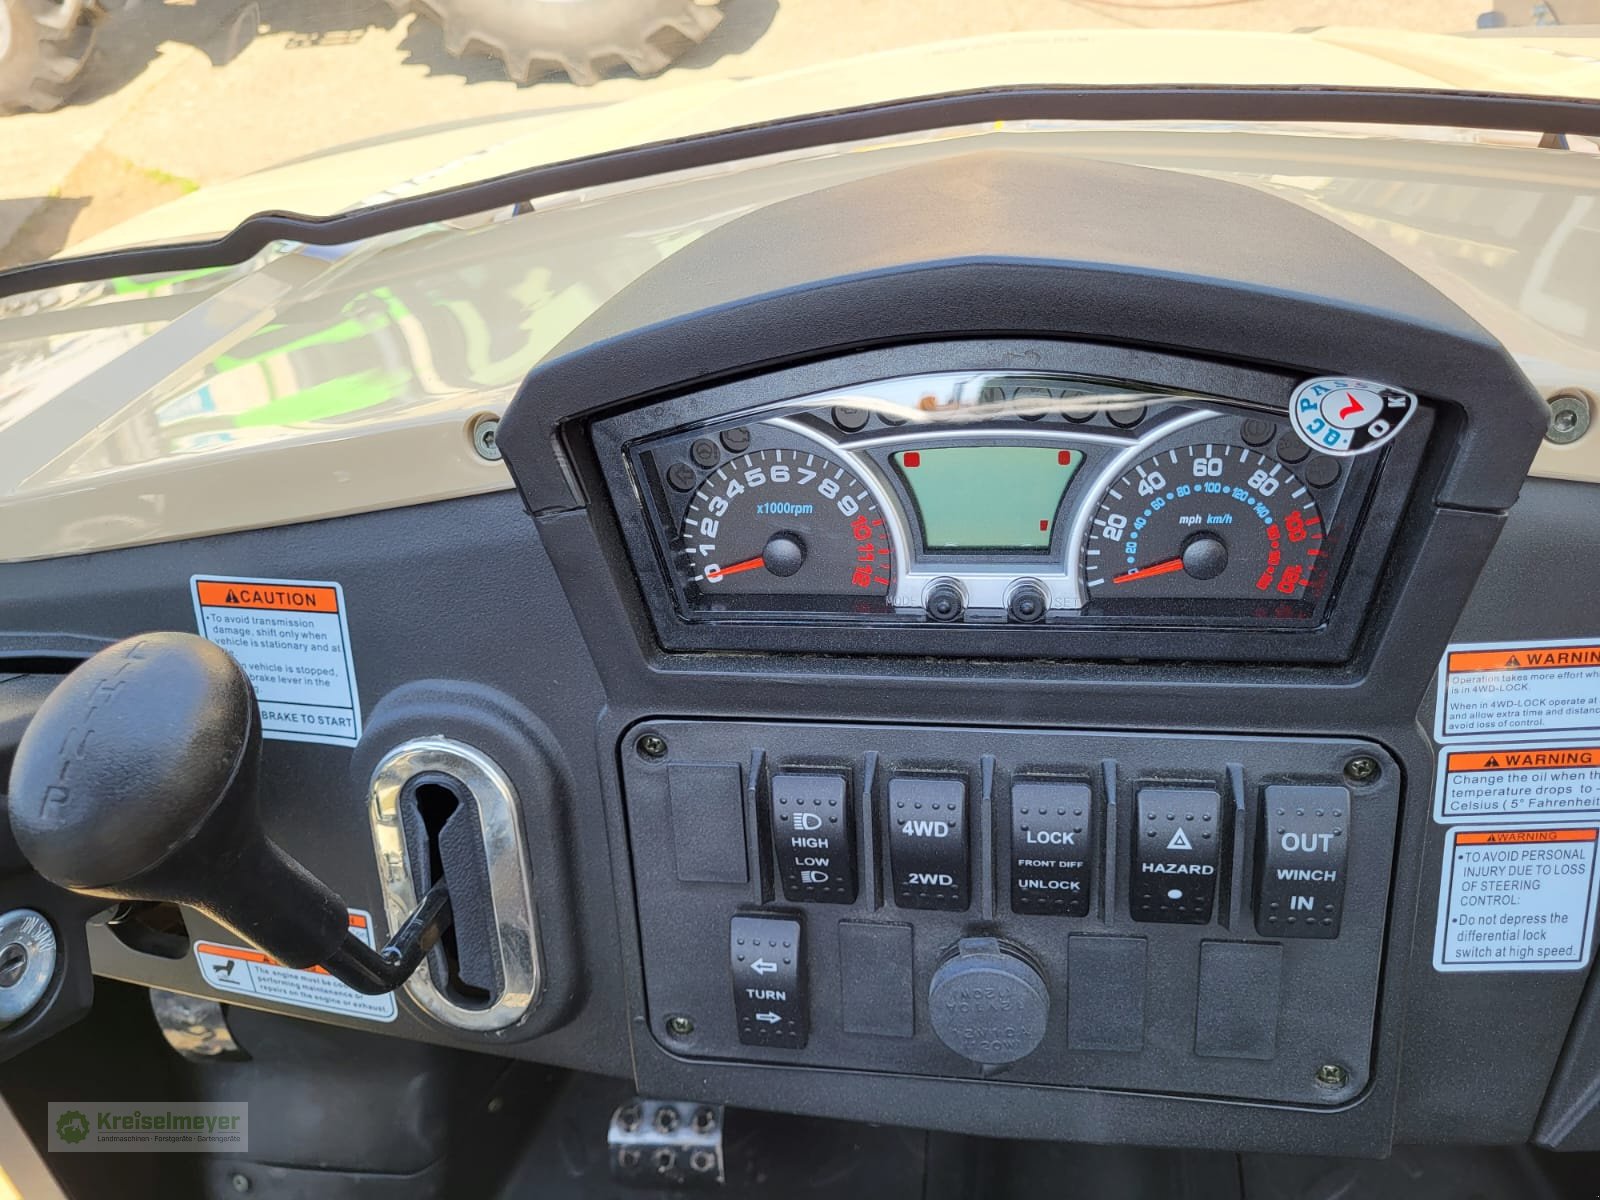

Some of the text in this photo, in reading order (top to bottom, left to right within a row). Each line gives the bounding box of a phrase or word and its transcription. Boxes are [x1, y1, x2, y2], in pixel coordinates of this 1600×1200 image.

[770, 465, 790, 482] 6
[1193, 457, 1223, 477] 60
[744, 467, 767, 487] 5
[797, 468, 816, 485] 7
[1247, 469, 1279, 497] 80
[725, 478, 745, 499] 4
[817, 478, 840, 500] 8
[1137, 471, 1166, 497] 40
[1176, 485, 1191, 497] 80
[1204, 482, 1221, 493] 100
[1231, 487, 1249, 501] 120
[708, 495, 729, 517] 3
[756, 502, 813, 517] x1000rpm
[837, 495, 859, 517] 9
[1150, 497, 1166, 510] 60
[1252, 502, 1270, 519] 140
[1133, 516, 1147, 530] 40
[1179, 513, 1233, 527] mph km/h
[700, 518, 719, 538] 2
[851, 515, 872, 541] 10
[1102, 513, 1127, 542] 20
[699, 544, 716, 557] 1
[857, 543, 875, 563] 11
[1125, 541, 1137, 554] 20
[704, 563, 724, 584] 0
[851, 565, 873, 588] 12
[240, 589, 317, 607] CAUTION
[211, 614, 314, 628] To avoid transmission
[213, 625, 328, 641] damage, shift only when
[215, 637, 341, 652] vehicle is stationary and at
[249, 663, 282, 672] vehicle
[285, 665, 294, 673] is
[295, 666, 339, 677] stopped,
[250, 673, 330, 687] brake lever in the
[1452, 674, 1500, 685] Operation
[1502, 673, 1528, 682] takes
[1530, 673, 1555, 681] more
[1557, 671, 1583, 680] effort
[1461, 686, 1470, 694] in
[1450, 696, 1597, 711] When in 4WD-LOCK operate at
[262, 710, 352, 727] BRAKE TO START
[1449, 711, 1467, 720] and
[1469, 710, 1494, 719] allow
[1496, 709, 1520, 718] extra
[1522, 708, 1543, 717] time
[1545, 707, 1563, 715] and
[1448, 718, 1545, 730] avoid loss of control.
[1505, 752, 1592, 766] WARNING
[1453, 774, 1504, 786] Change
[1507, 772, 1528, 783] the
[1531, 771, 1547, 782] oil
[1550, 770, 1585, 781] when
[1451, 783, 1592, 799] temperature drops to
[1450, 799, 1499, 811] Celsius
[902, 820, 949, 838] 4WD
[791, 837, 829, 849] HIGH
[1026, 830, 1075, 845] LOCK
[1281, 832, 1335, 853] OUT
[1497, 832, 1557, 842] WARNING
[794, 857, 830, 867] LOW
[1466, 849, 1586, 863] TO AVOID PERSONAL
[1018, 859, 1084, 869] FRONT DIFF
[1142, 863, 1215, 876] HAZARD
[1463, 863, 1586, 877] INJURY DUE TO LOSS
[908, 873, 953, 886] 2WD
[1277, 869, 1337, 882] WINCH
[1018, 880, 1081, 891] UNLOCK
[1461, 879, 1541, 892] OF STEERING
[1290, 896, 1314, 911] IN
[1460, 895, 1520, 907] CONTROL:
[1459, 912, 1568, 926] Do not depress the
[1457, 929, 1546, 942] differential lock
[1455, 945, 1576, 959] switch at high speed.
[257, 976, 300, 989] performing
[746, 988, 786, 1001] TURN
